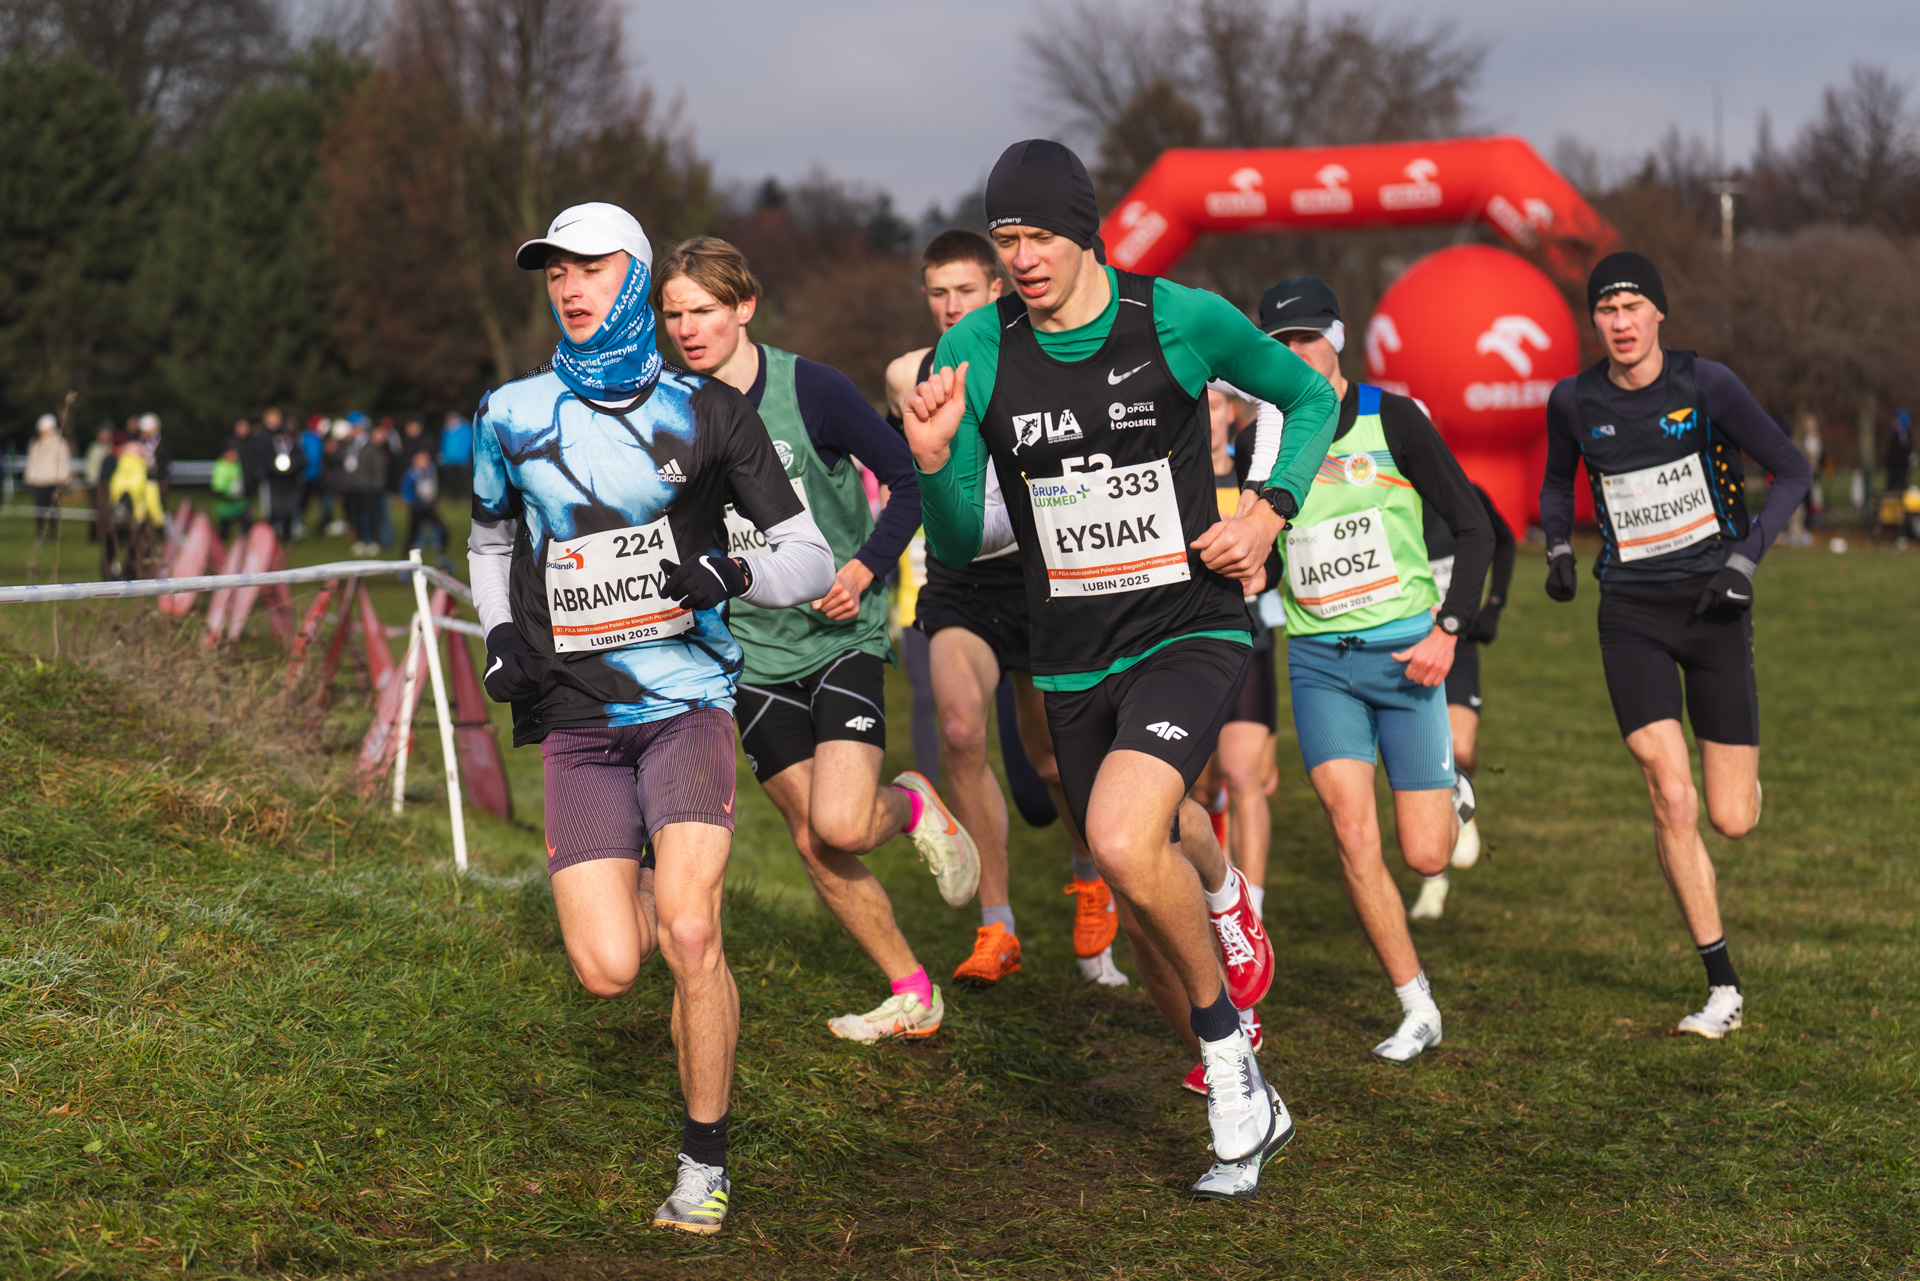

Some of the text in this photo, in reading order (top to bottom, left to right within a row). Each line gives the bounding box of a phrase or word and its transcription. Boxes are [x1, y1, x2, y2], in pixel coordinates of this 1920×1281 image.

[1127, 405, 1155, 414] OPOLE
[1116, 419, 1157, 430] OPOLSKIE
[653, 473, 687, 483] adidas
[1106, 469, 1159, 499] 333
[1657, 464, 1692, 486] 444
[1032, 485, 1068, 497] GRUPA
[1034, 494, 1077, 508] LUXMED
[1614, 488, 1707, 529] ZAKRZEWSKI
[1056, 514, 1161, 553] ŁYSIAK
[1333, 517, 1371, 540] 699
[613, 529, 664, 559] 224
[547, 561, 575, 571] polanik
[1123, 561, 1146, 571] Biegach
[1300, 549, 1380, 586] JAROSZ
[553, 570, 671, 612] ABRAMCZY
[1082, 574, 1150, 592] LUBIN 2025
[1320, 595, 1373, 615] LUBIN 2025
[609, 621, 625, 630] Polski
[631, 616, 654, 625] Biegach
[590, 626, 658, 647] LUBIN 2025
[845, 715, 876, 732] 4F
[1146, 721, 1189, 741] 4F
